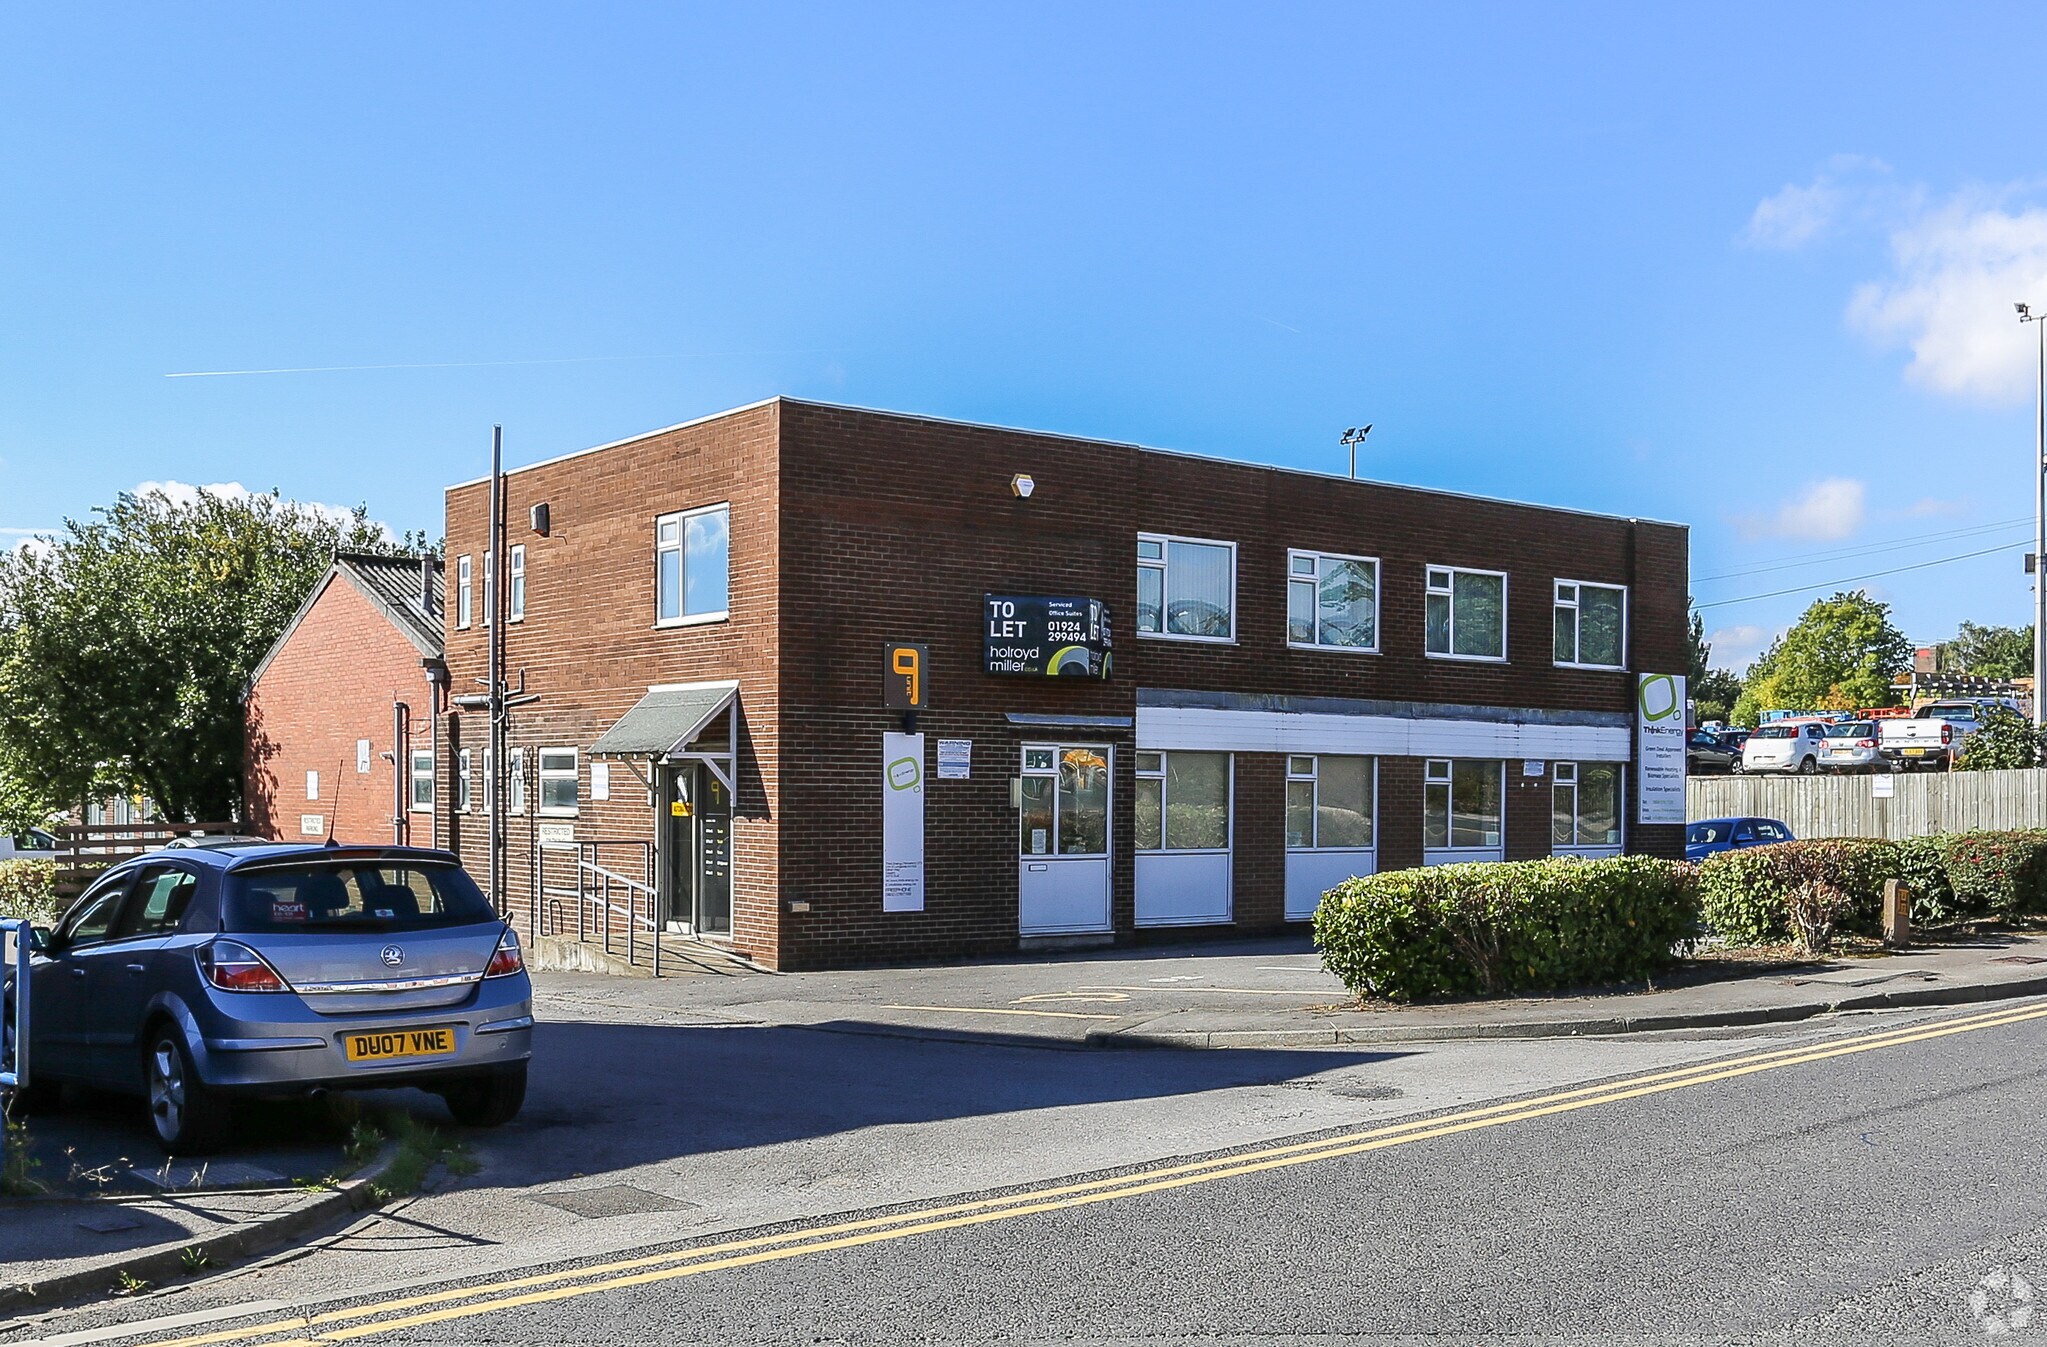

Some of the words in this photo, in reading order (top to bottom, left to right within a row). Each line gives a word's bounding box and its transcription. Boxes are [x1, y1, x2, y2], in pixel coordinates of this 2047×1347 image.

[990, 601, 1014, 618] TO
[990, 620, 1027, 638] LET
[1048, 622, 1080, 631] 01924
[1048, 632, 1086, 642] 299494
[990, 646, 1039, 660] holroyd
[893, 648, 918, 705] 9
[272, 903, 304, 912] heart
[355, 1034, 405, 1056] DU07
[411, 1031, 447, 1051] VNE
